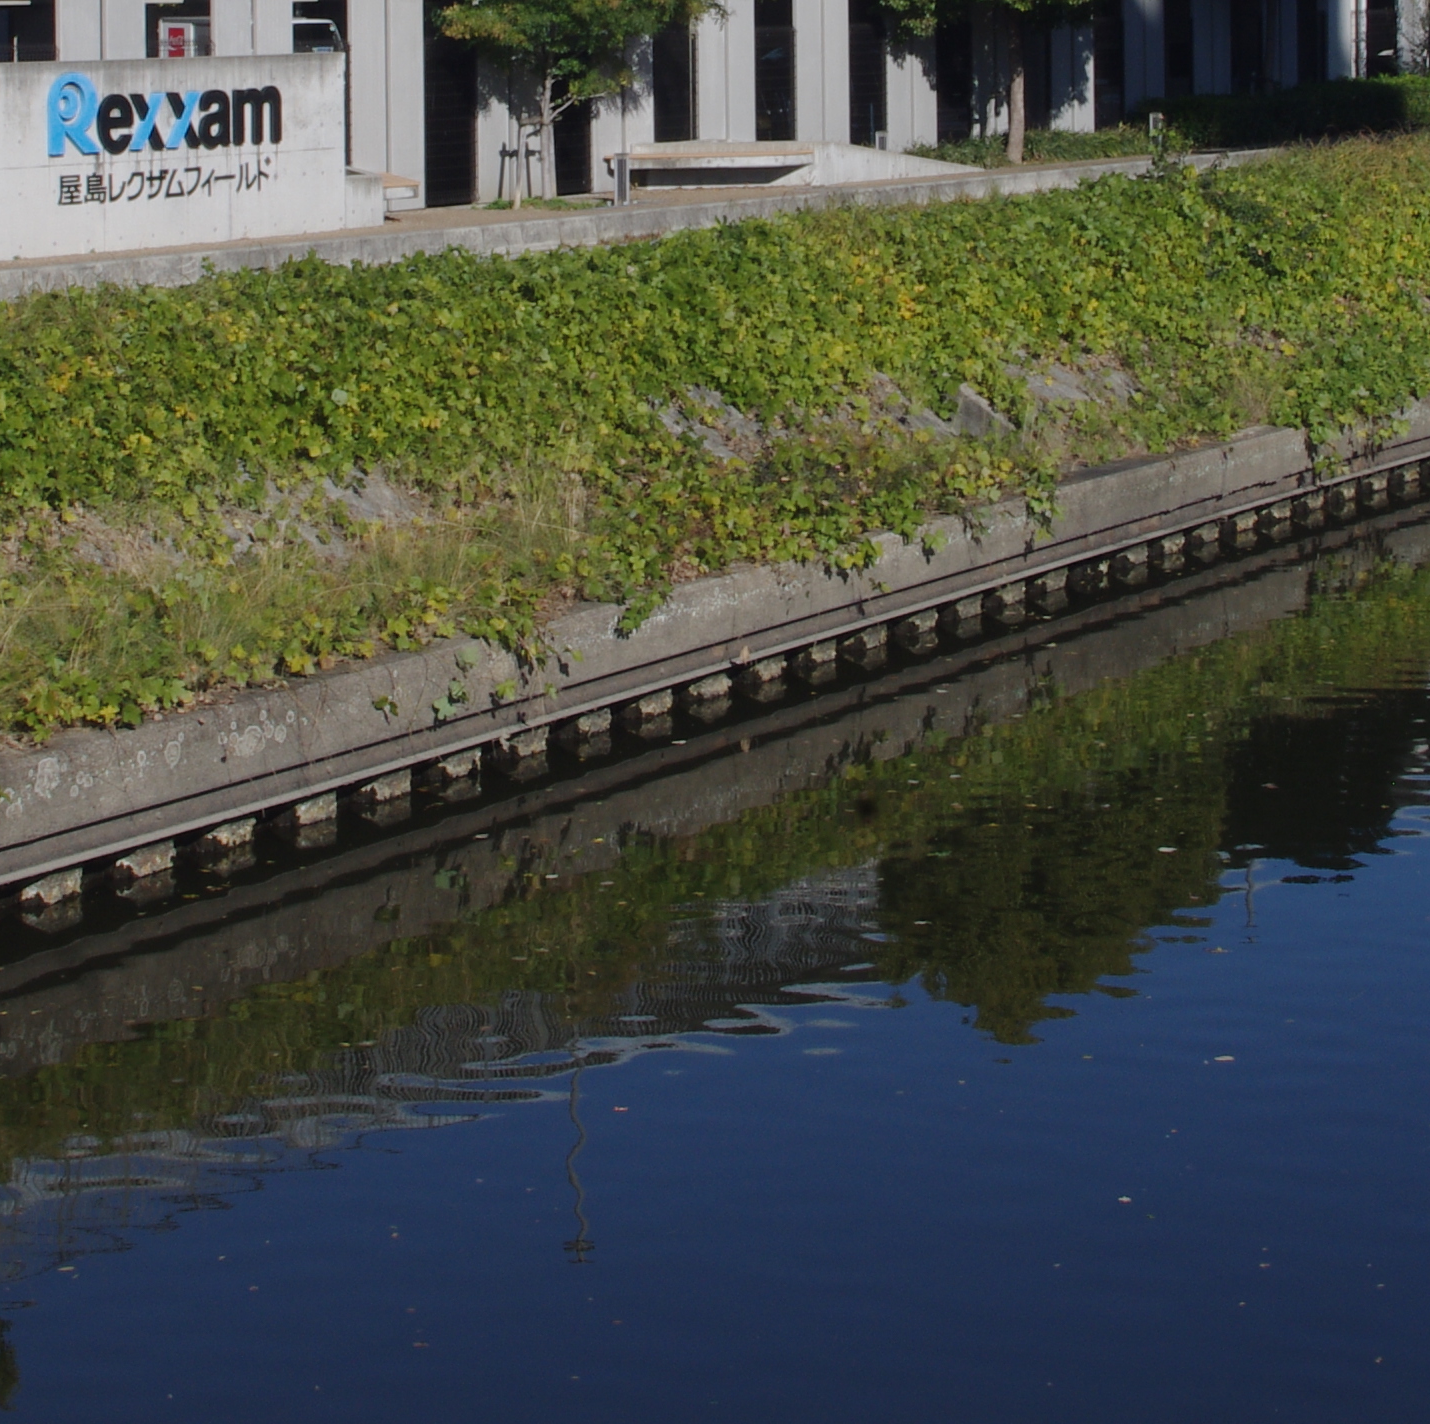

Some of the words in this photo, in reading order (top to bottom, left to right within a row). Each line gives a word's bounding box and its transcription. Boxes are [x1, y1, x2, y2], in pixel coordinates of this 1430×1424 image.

[47, 72, 282, 157] Rexxam
[57, 156, 272, 206] 屋島レクザムフィールド
